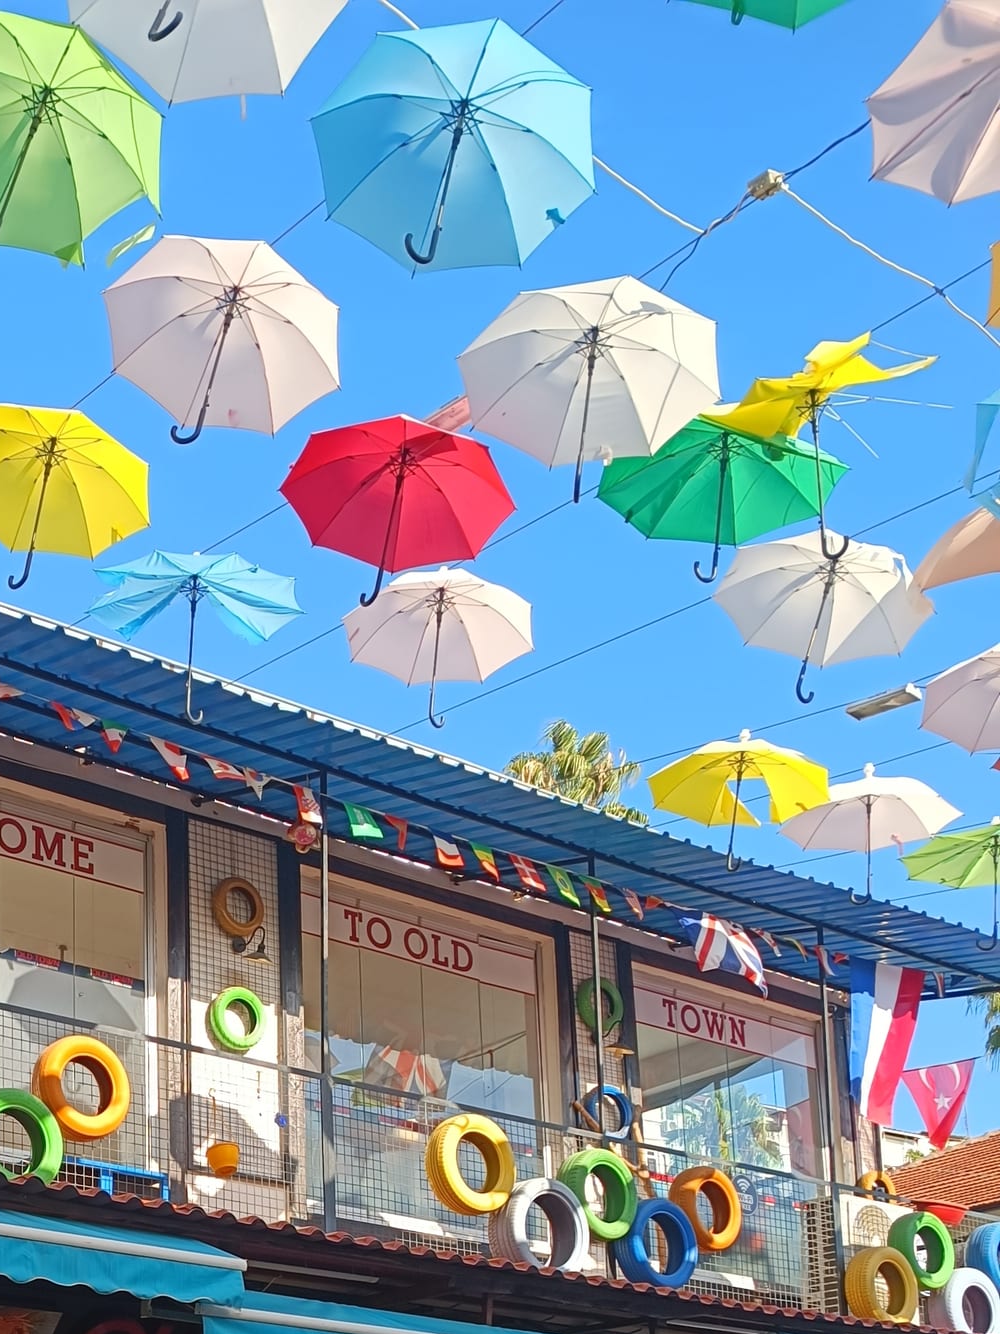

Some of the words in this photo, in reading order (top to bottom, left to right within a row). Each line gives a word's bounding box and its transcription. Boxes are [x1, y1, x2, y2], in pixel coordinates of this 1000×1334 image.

[344, 909, 392, 949] TO
[404, 928, 473, 972] OLD
[662, 998, 746, 1047] TOWN
